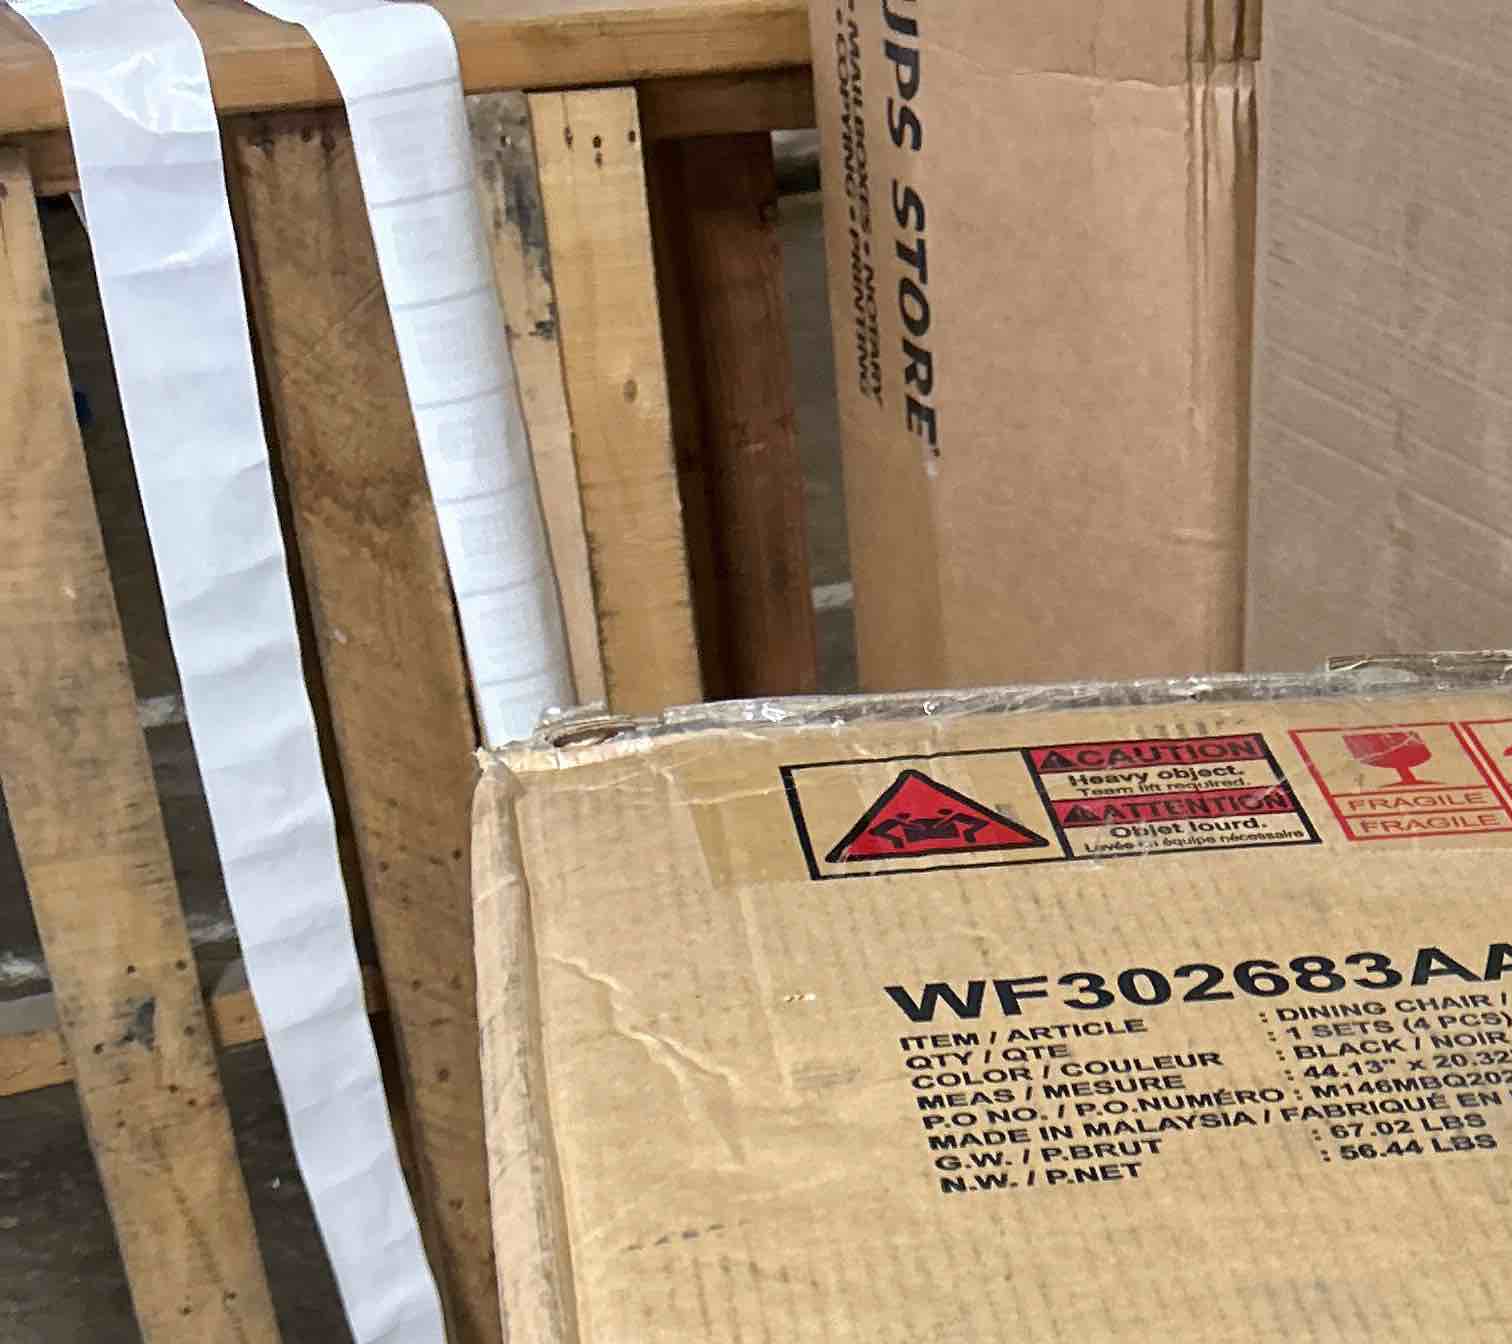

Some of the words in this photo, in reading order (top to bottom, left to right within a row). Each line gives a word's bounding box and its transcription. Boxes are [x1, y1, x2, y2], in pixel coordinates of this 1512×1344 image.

[891, 178, 938, 448] STORE
[1076, 737, 1259, 768] CAUTION
[1068, 770, 1149, 787] Heavy
[1157, 764, 1244, 782] object.
[1076, 785, 1134, 797] Team
[1102, 792, 1288, 821] ATTENTION
[1348, 792, 1488, 811] FRAGILE
[1109, 822, 1183, 840] Objet
[1189, 816, 1267, 834] lourd.
[1360, 815, 1500, 833] FRAGILE
[900, 1033, 980, 1050] ITEM
[1007, 1019, 1148, 1042] ARTICLE
[1276, 1002, 1386, 1021] DINING
[1395, 994, 1492, 1013] CHAIR
[906, 1051, 973, 1070] QTY
[1002, 1044, 1071, 1062] QTE
[1286, 1026, 1301, 1041] 1
[1312, 1020, 1394, 1038] SETS
[1403, 1017, 1430, 1033] (4
[1438, 1011, 1512, 1028] PCS)
[911, 1067, 1032, 1090] COLOR
[1061, 1053, 1224, 1077] COULEUR
[1293, 1039, 1407, 1060] BLACK
[1430, 1031, 1510, 1049] NOIR
[916, 1089, 1015, 1110] MEAS
[1043, 1075, 1186, 1099] MESURE
[1303, 1058, 1396, 1079] 44.13"
[922, 1112, 978, 1130] P.O
[986, 1107, 1049, 1125] NO.
[928, 1129, 1032, 1151] MADE
[1039, 1125, 1073, 1141] IN
[1082, 1111, 1257, 1137] MALAYSIA
[1280, 1092, 1451, 1122] FABRIQUÉ
[1456, 1091, 1503, 1108] EN
[935, 1152, 1012, 1171] G.W.
[1041, 1138, 1162, 1162] P.BRUT
[1329, 1119, 1414, 1139] 67.02
[1421, 1113, 1487, 1133] LBS
[940, 1172, 1018, 1193] N.W.
[1045, 1162, 1141, 1185] P.NET
[1339, 1139, 1424, 1161] 56.44
[1431, 1133, 1497, 1153] LBS
